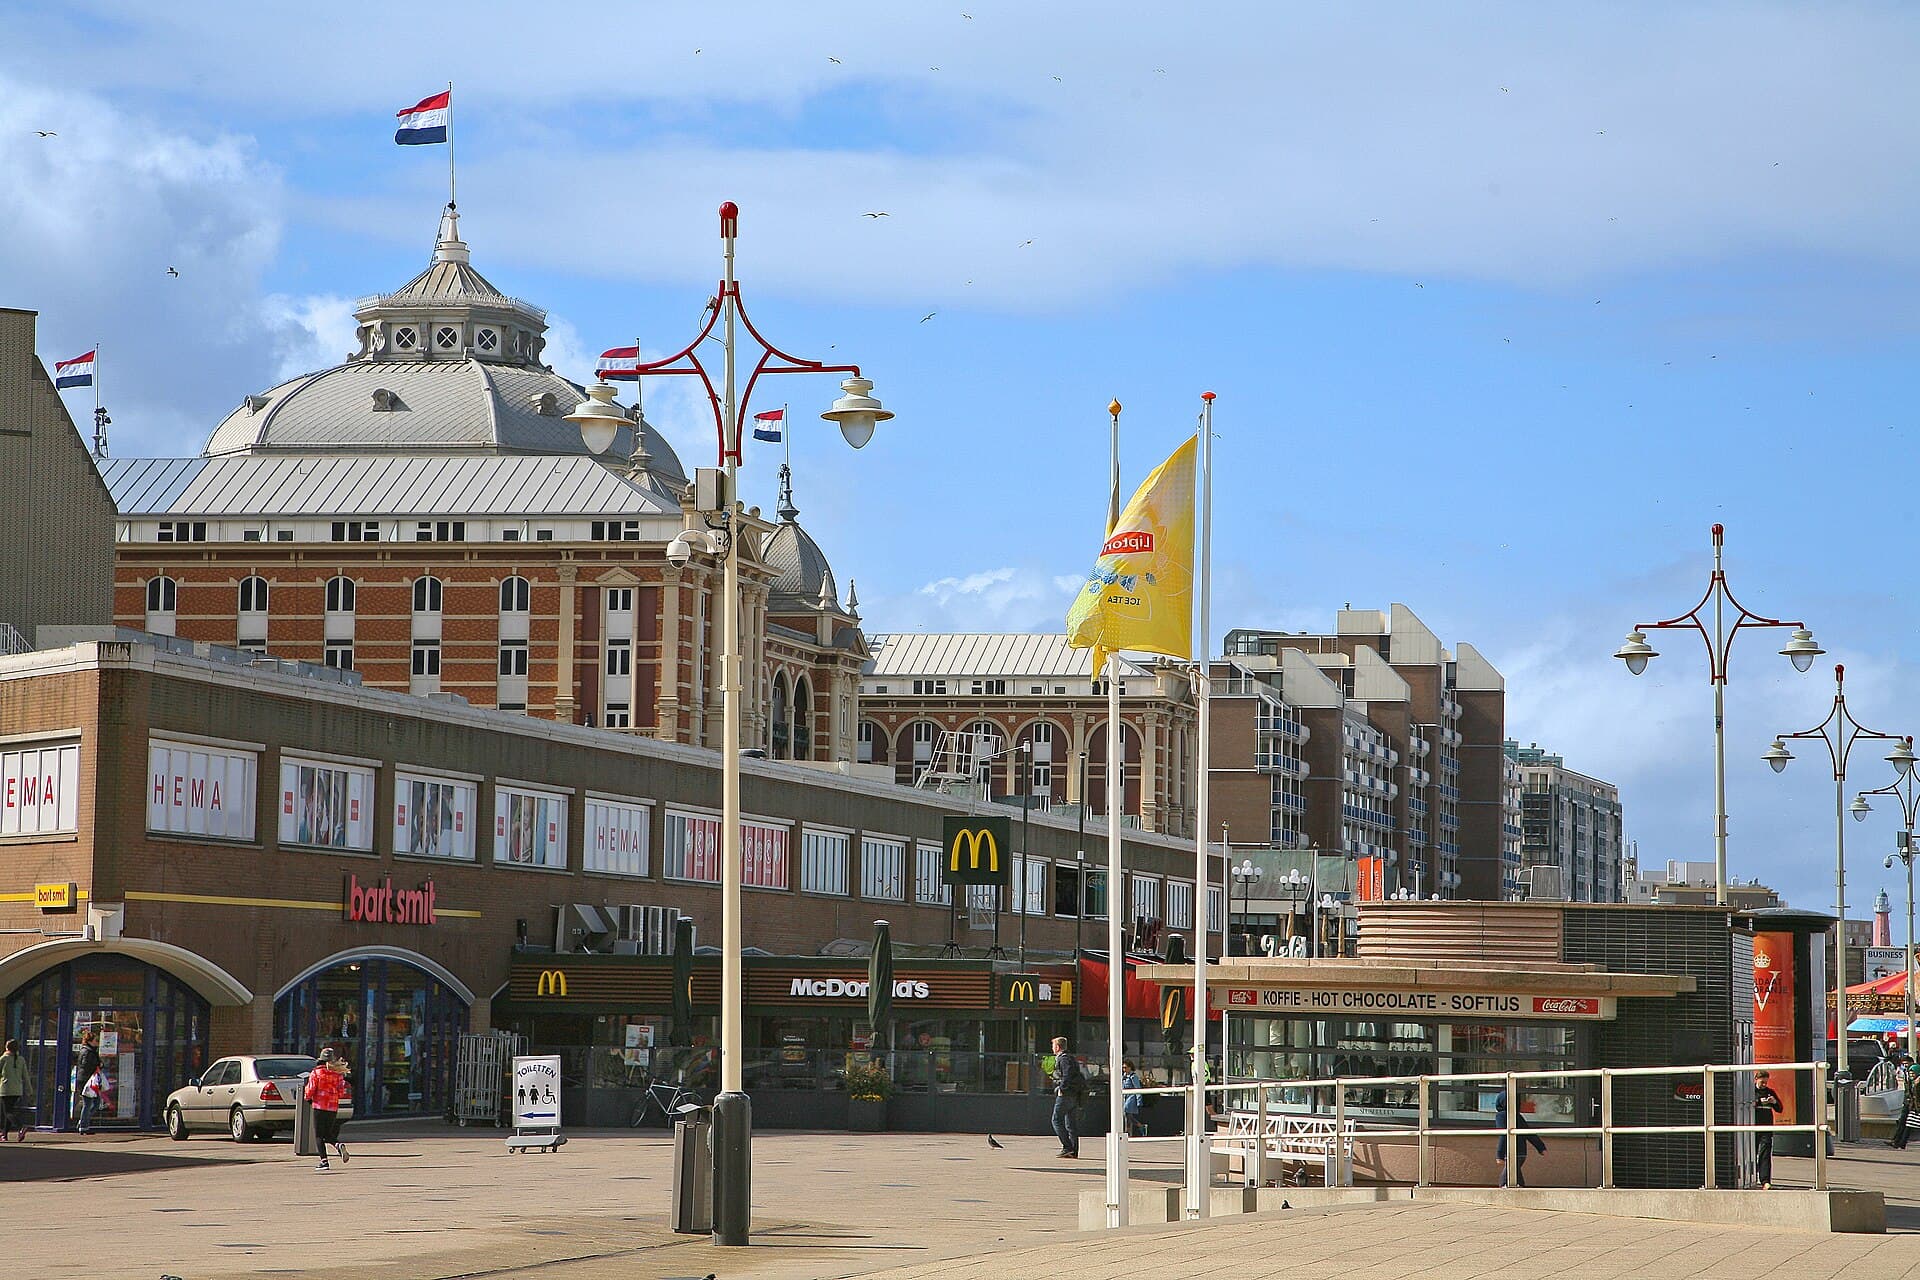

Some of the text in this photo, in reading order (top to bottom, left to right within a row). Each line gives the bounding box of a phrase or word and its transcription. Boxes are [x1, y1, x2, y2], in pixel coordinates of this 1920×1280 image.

[154, 774, 223, 811] HEMA
[597, 826, 639, 854] HEMA
[38, 888, 66, 902] bart smit
[349, 874, 437, 925] bart smit
[1868, 951, 1904, 959] BUSINESS
[790, 978, 929, 999] McDonld's
[1263, 990, 1301, 1006] KOFFIE
[1312, 991, 1339, 1007] HOT
[1343, 992, 1436, 1009] CHOCOLATE
[1451, 995, 1520, 1012] SOFTIJS
[517, 1064, 557, 1079] TOILETTEN
